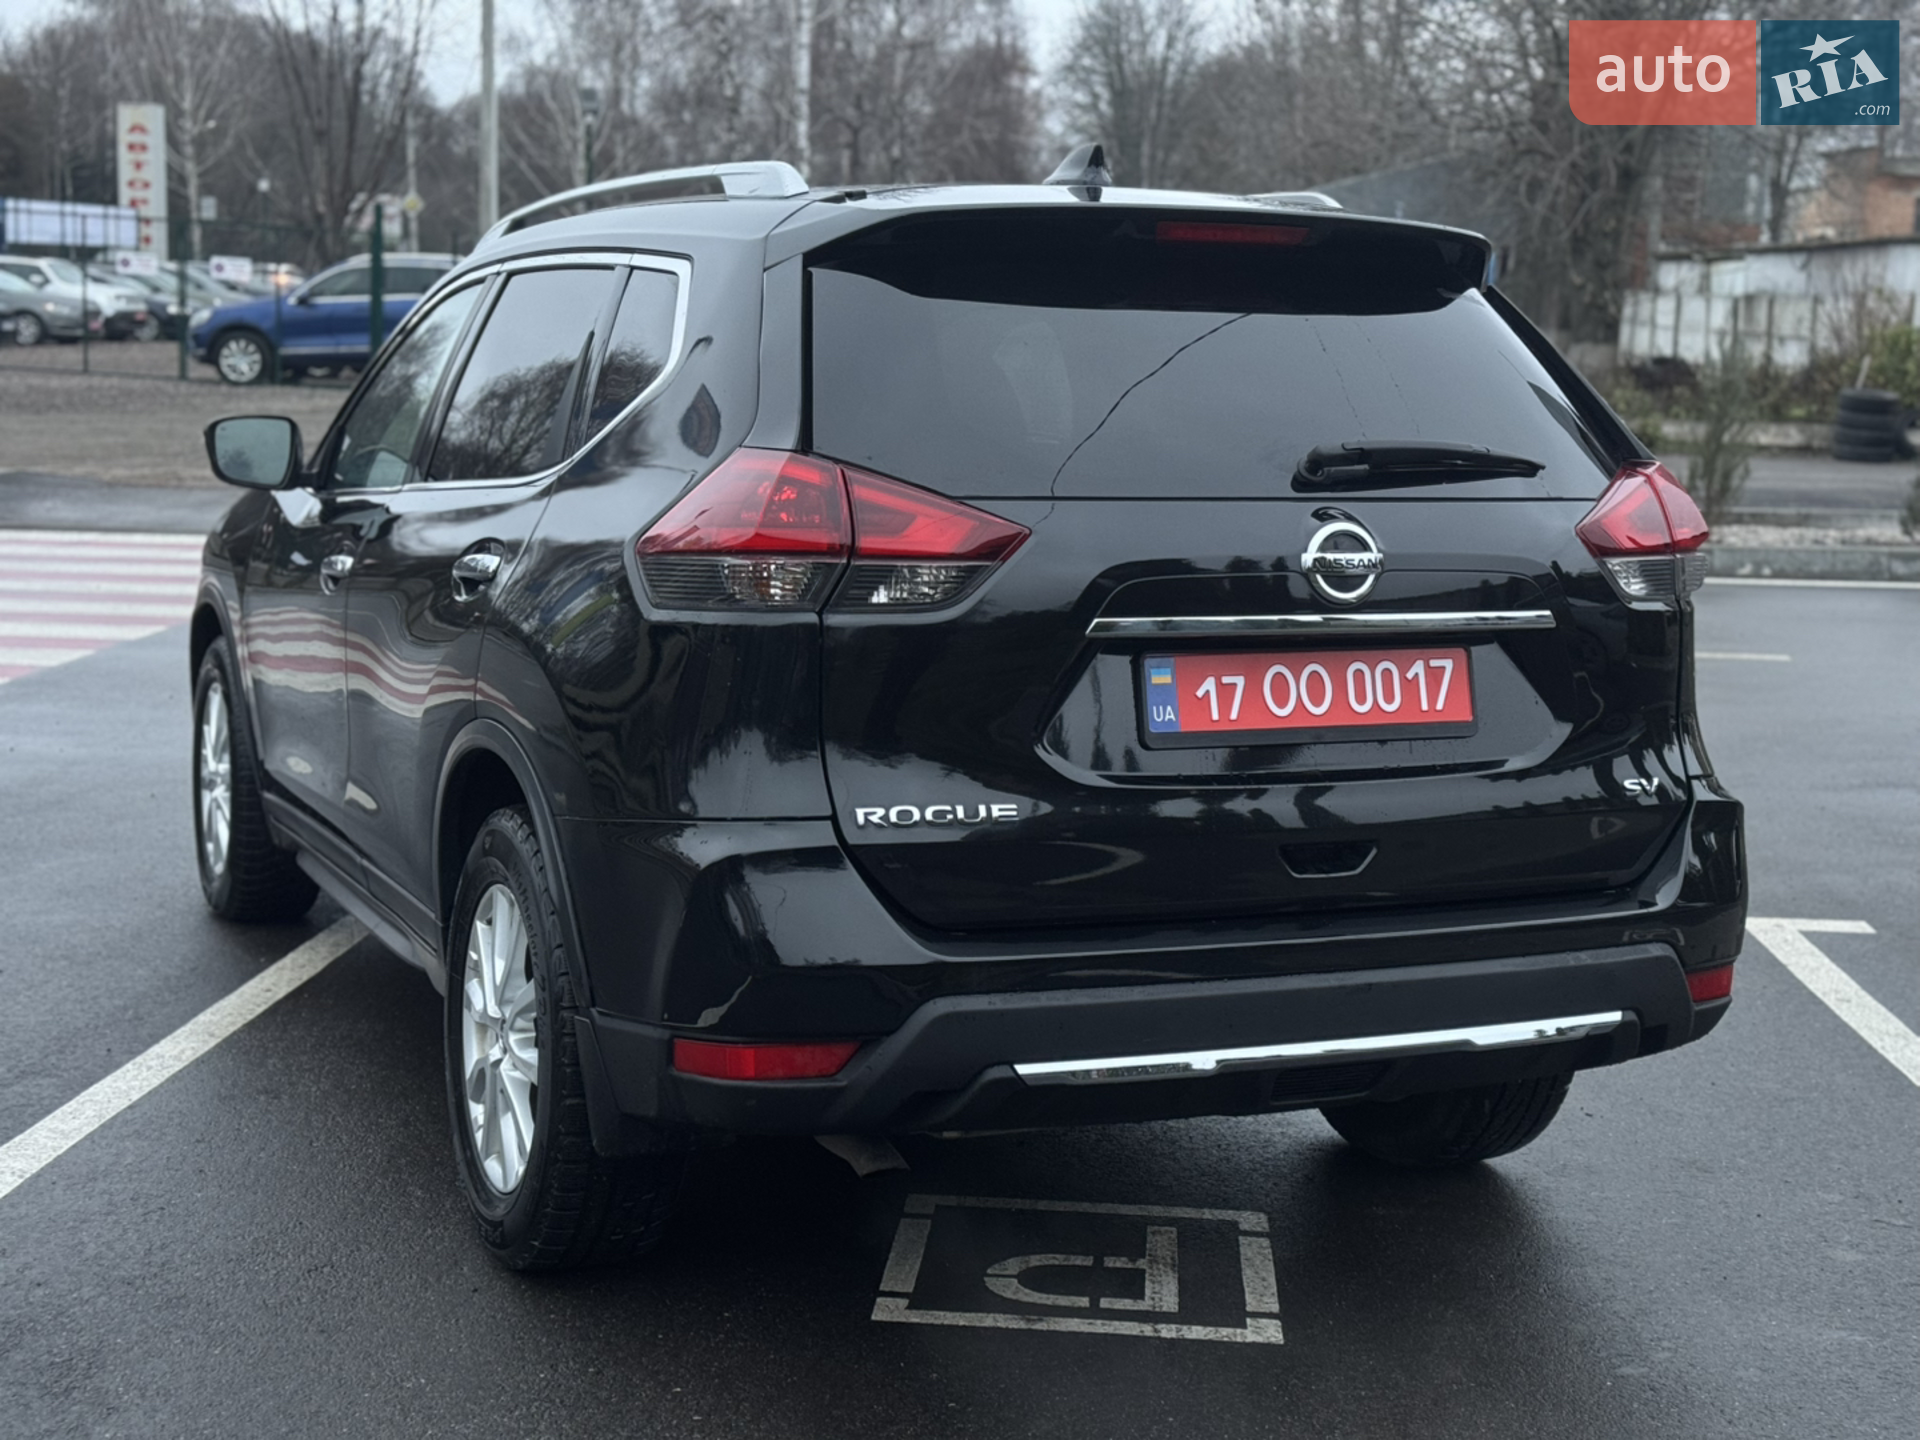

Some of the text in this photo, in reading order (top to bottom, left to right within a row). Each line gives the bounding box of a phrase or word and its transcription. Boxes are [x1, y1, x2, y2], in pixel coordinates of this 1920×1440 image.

[1312, 556, 1379, 571] NISSAN
[1195, 675, 1245, 721] 17
[1346, 658, 1453, 714] 0017
[1153, 705, 1176, 722] UA
[1623, 777, 1659, 796] SV
[855, 804, 1019, 828] ROGUE
[983, 1226, 1179, 1313] P
